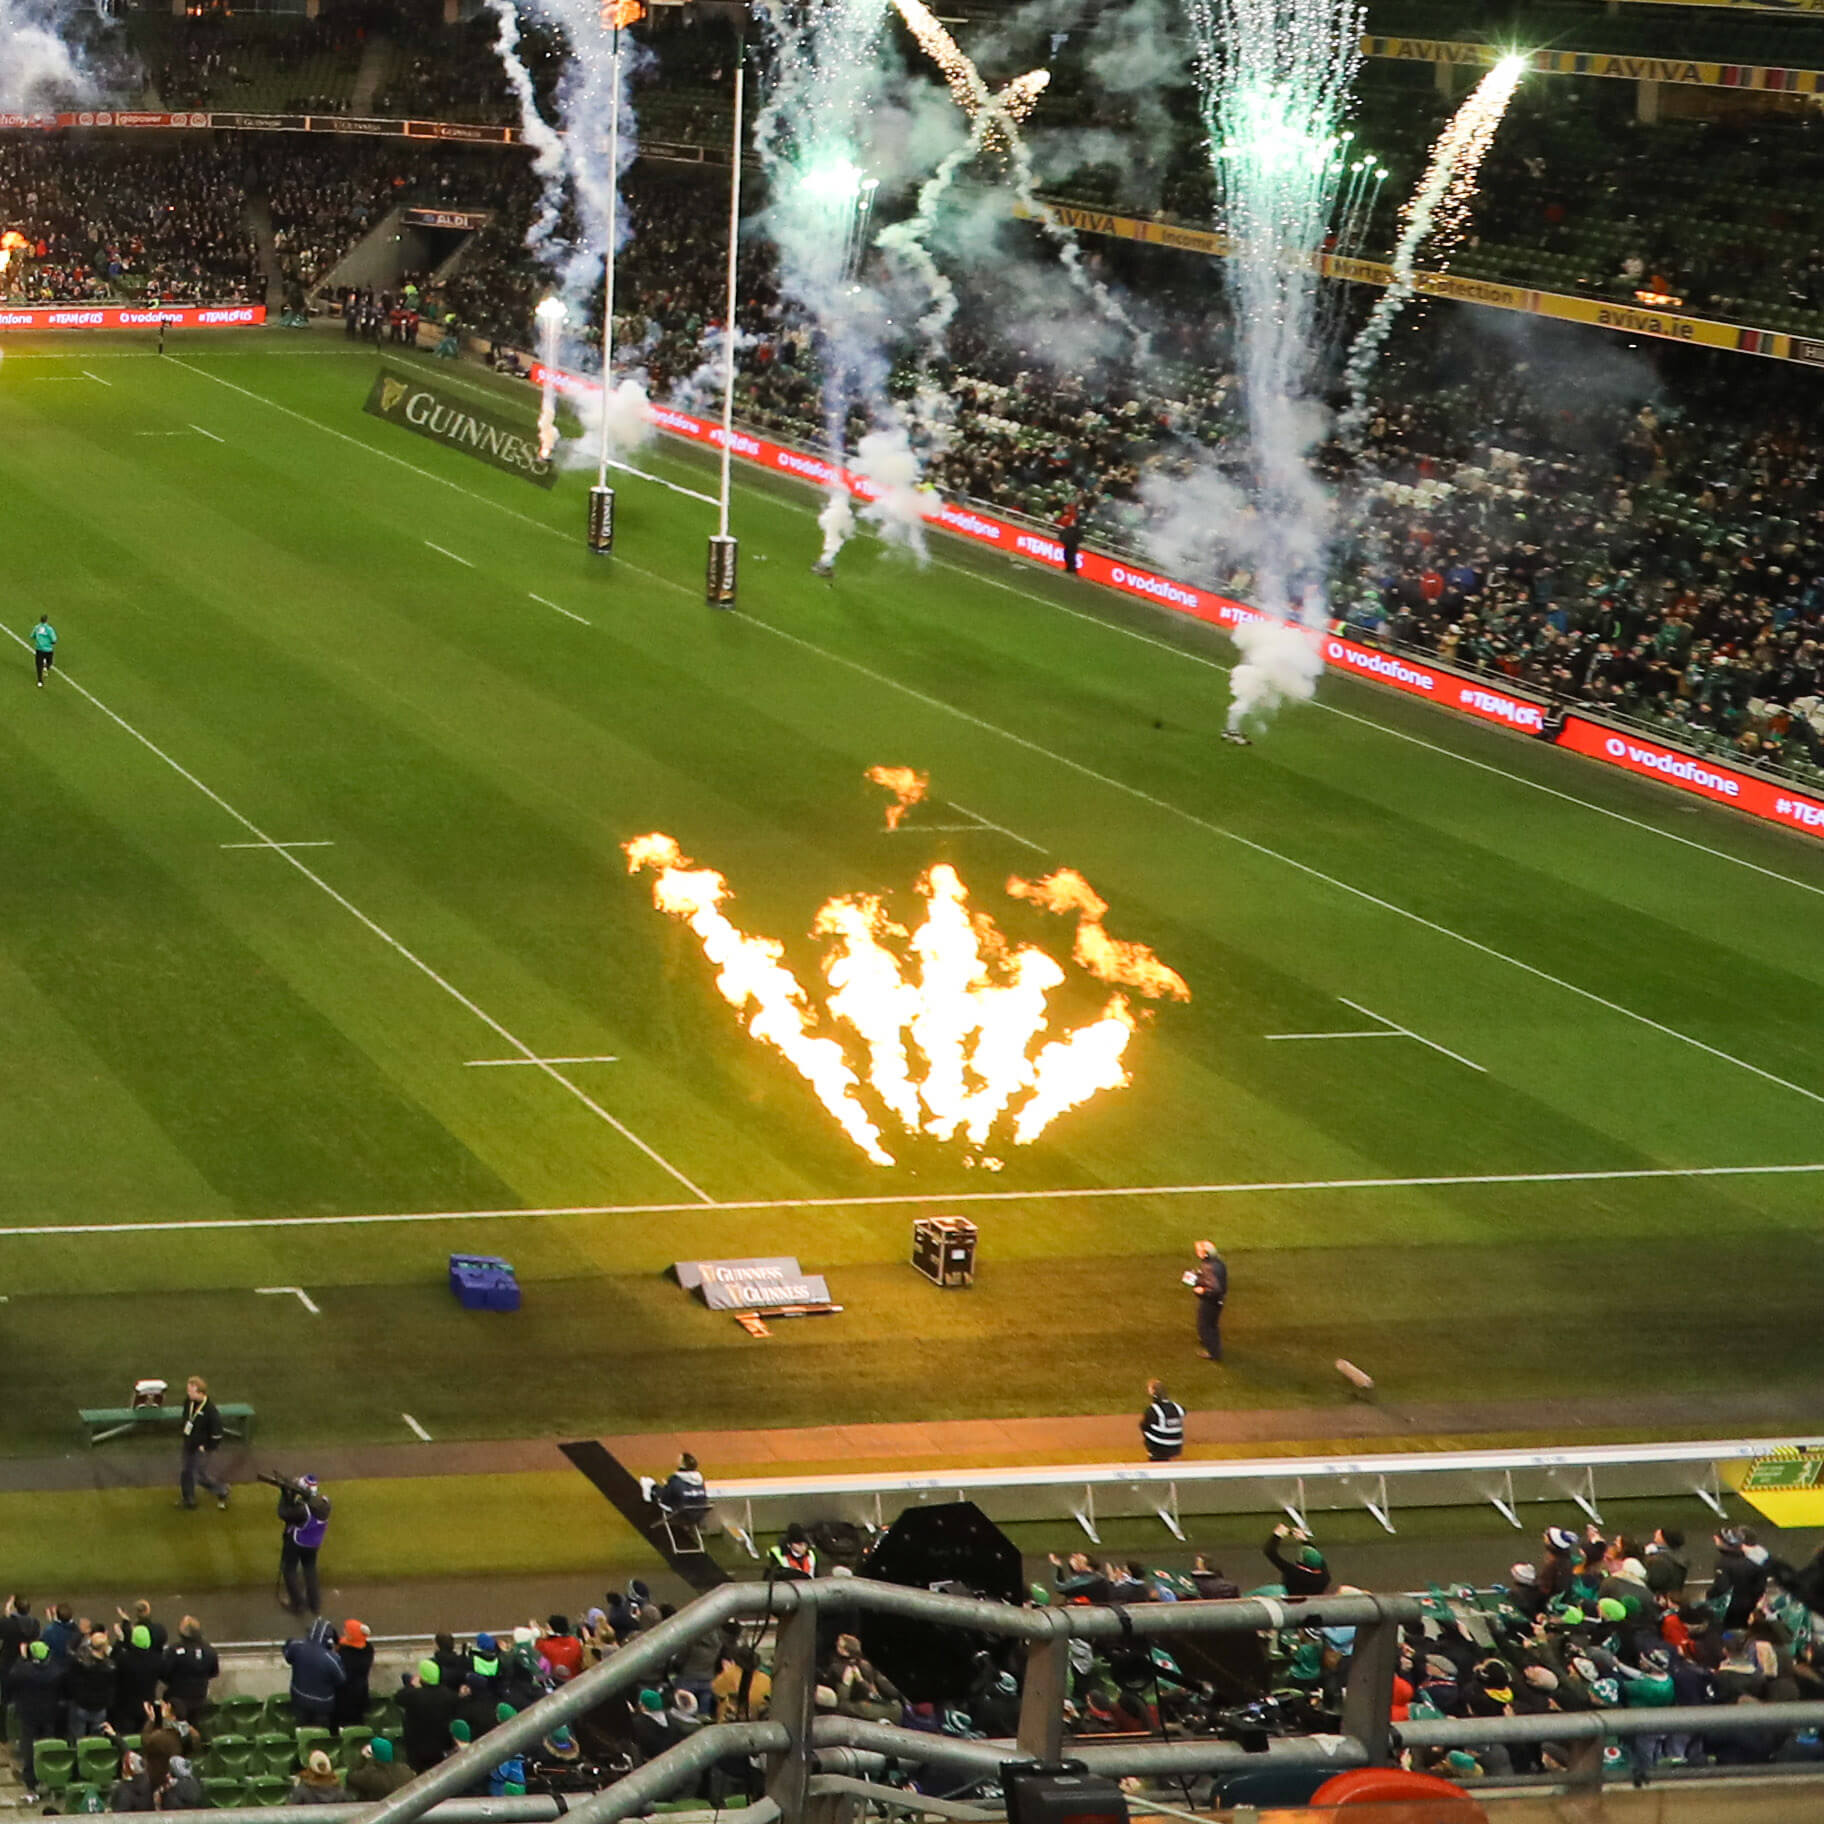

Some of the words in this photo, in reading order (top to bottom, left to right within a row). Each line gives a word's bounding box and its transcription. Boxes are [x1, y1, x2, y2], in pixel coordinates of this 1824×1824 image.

[1397, 41, 1480, 65] AVIVA
[1604, 56, 1704, 83] AVIVA
[436, 214, 468, 226] ALDI
[1161, 228, 1214, 251] Income
[130, 313, 183, 324] vodafone
[1598, 308, 1694, 339] aviva.ie
[1127, 571, 1199, 608] vodafone
[1346, 648, 1435, 691] vodafone
[1627, 745, 1740, 798] vodafone
[715, 1265, 784, 1282] GUINNESS
[743, 1284, 811, 1302] GUINNESS
